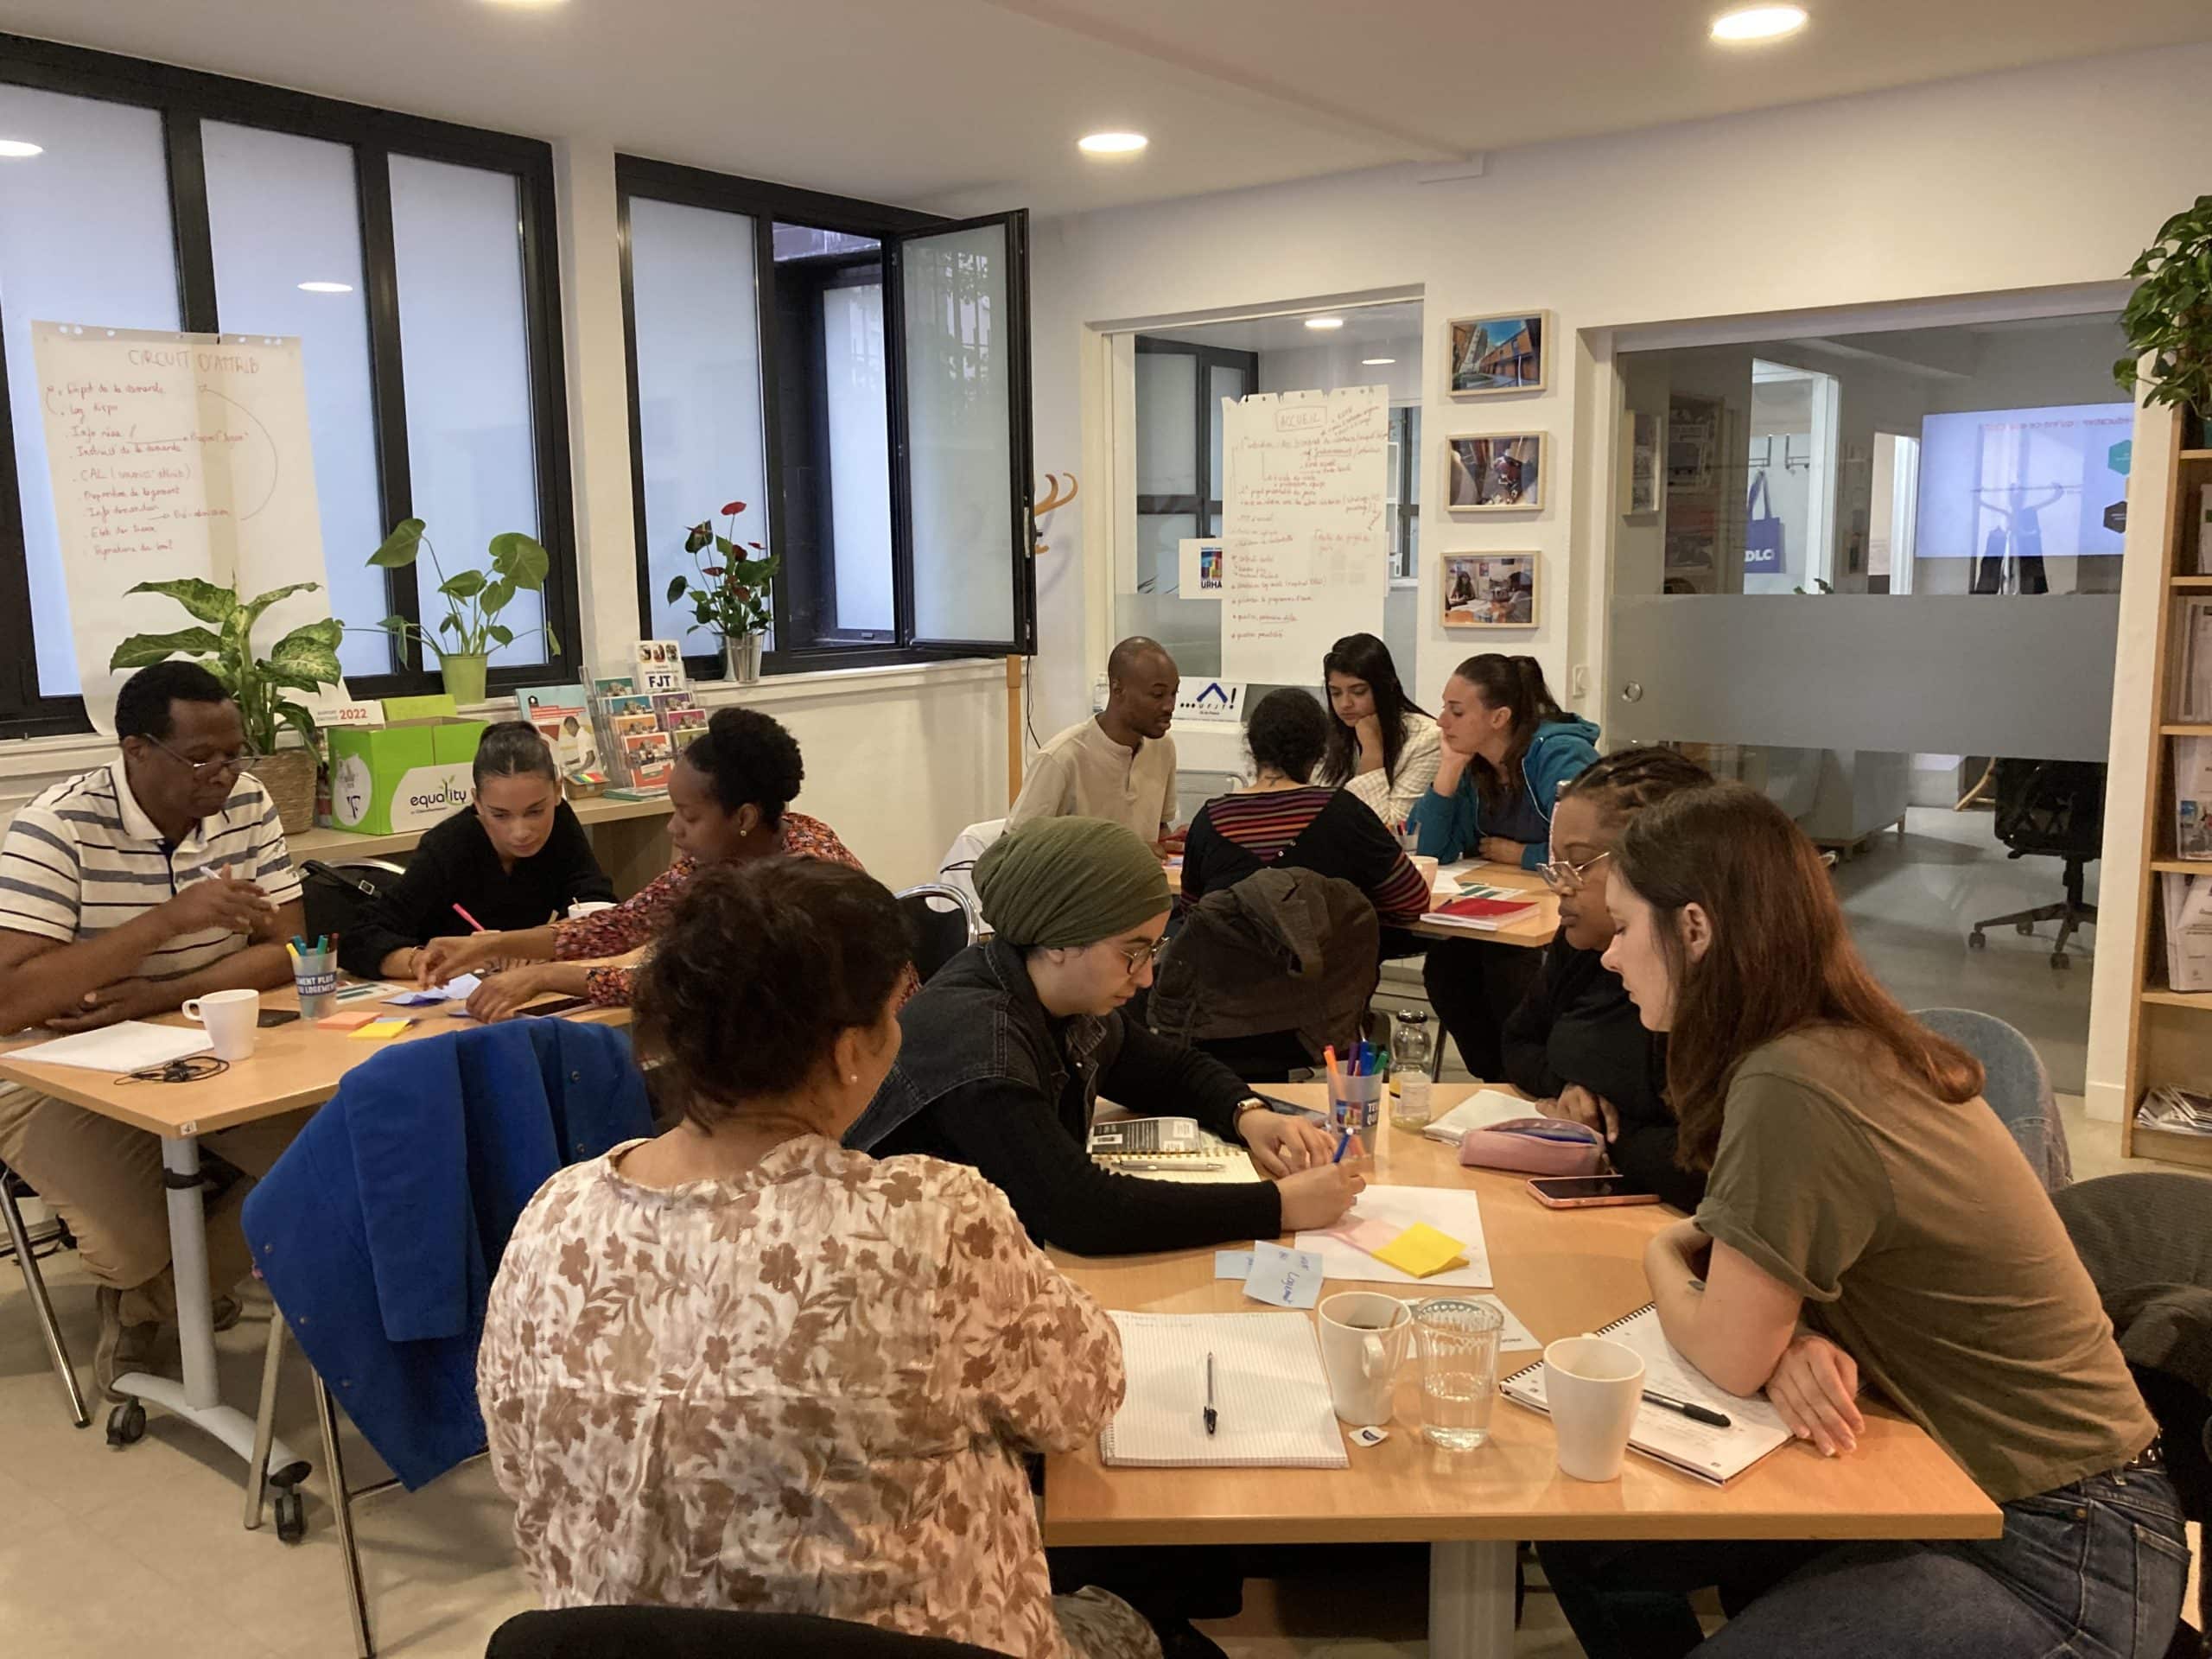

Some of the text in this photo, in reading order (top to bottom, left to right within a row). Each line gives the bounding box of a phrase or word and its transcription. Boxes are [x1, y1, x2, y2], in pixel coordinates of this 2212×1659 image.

[129, 350, 189, 370] CIRCUIT
[648, 675, 671, 688] FJT
[339, 709, 367, 720] 2022
[410, 782, 467, 808] equality
